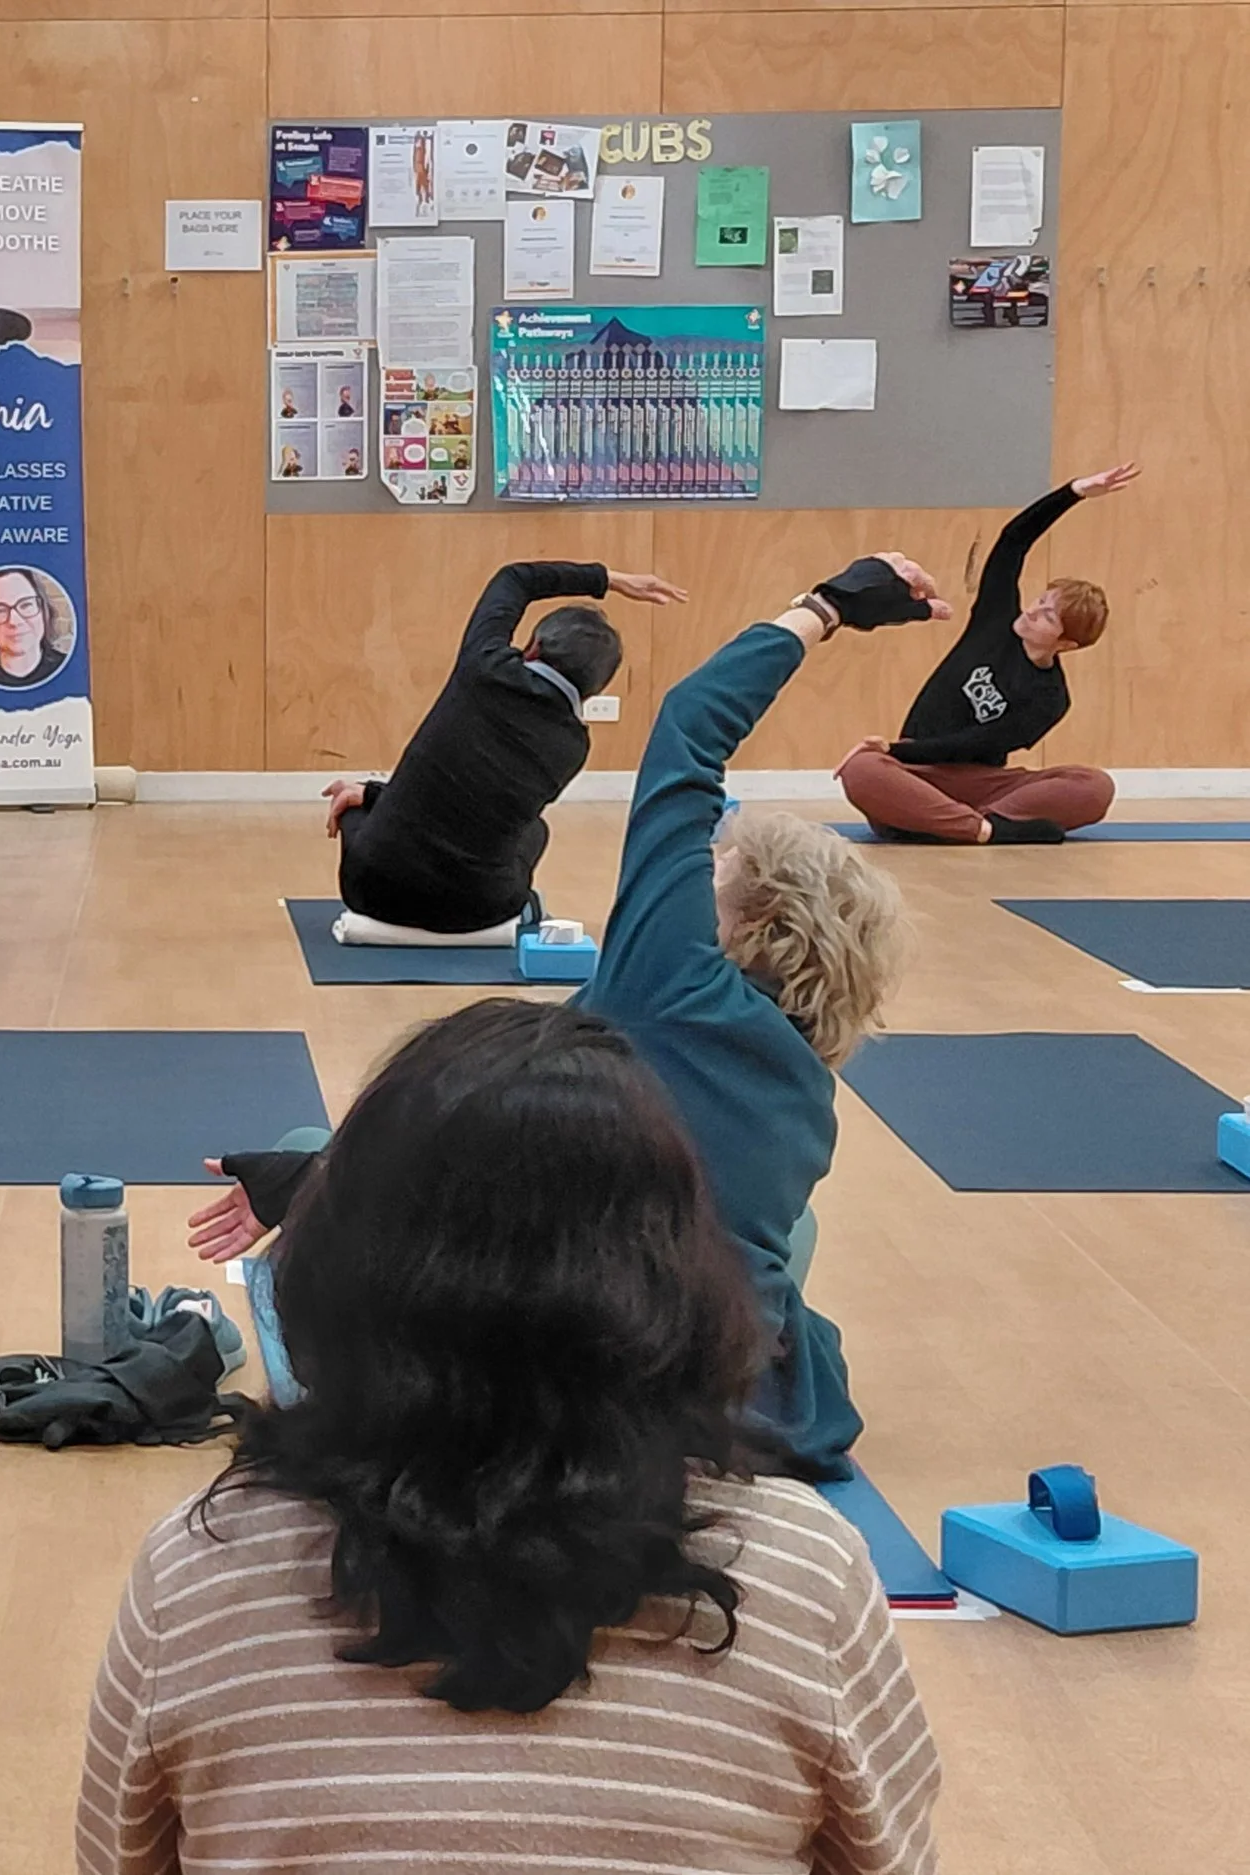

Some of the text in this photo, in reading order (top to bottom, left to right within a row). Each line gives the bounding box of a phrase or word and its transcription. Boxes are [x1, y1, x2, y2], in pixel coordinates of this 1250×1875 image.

[275, 130, 311, 143] Feeling
[599, 119, 713, 165] CUBS
[179, 210, 242, 220] PLACE YOUR
[182, 223, 239, 233] BAGS HERE
[518, 311, 592, 324] Achievement
[517, 327, 574, 340] Pathways
[0, 527, 70, 543] AWARE
[42, 725, 82, 749] Yoga
